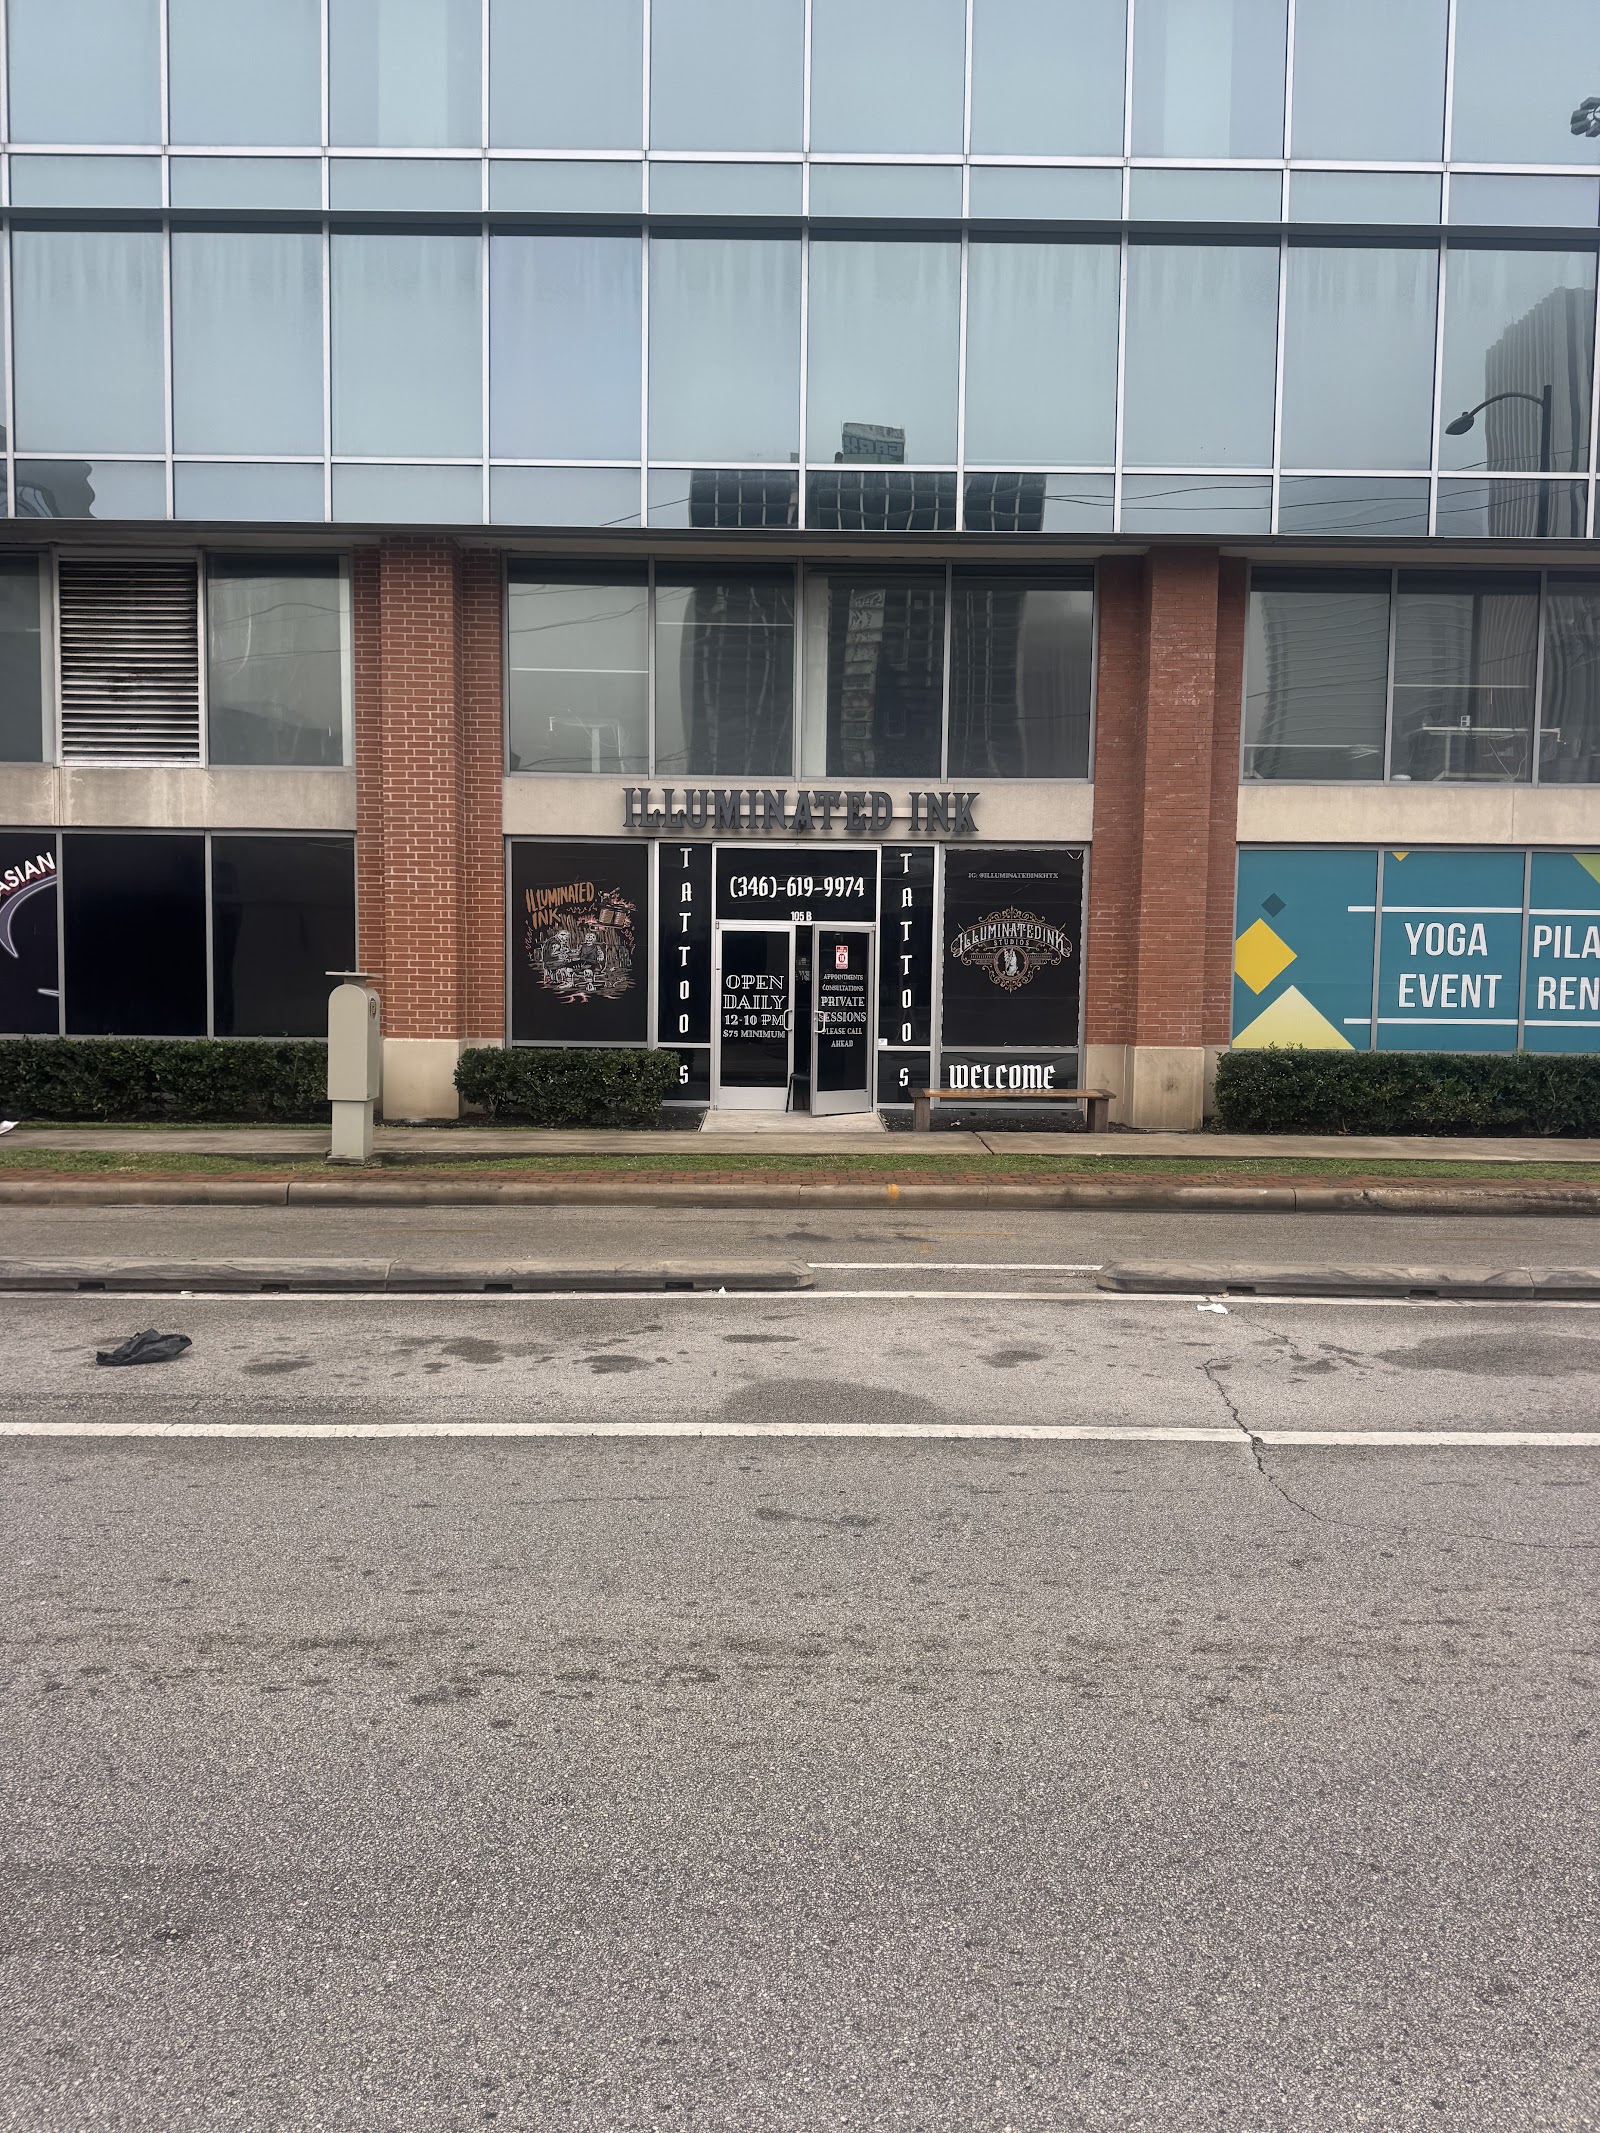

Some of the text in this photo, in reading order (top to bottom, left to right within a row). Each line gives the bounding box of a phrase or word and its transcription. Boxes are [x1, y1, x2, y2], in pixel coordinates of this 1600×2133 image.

[622, 787, 981, 833] ILLUMINATED INK
[729, 876, 865, 899] (346)-619-9974
[525, 881, 595, 913] ILLUMINATED
[531, 907, 562, 930] INK
[790, 911, 812, 921] 105 B
[993, 938, 1030, 946] STUDIOS
[1404, 922, 1488, 956] YOGA
[1532, 925, 1600, 959] PILA
[725, 974, 785, 990] OPEN
[822, 973, 864, 981] APPOINTMENTS
[821, 983, 864, 992] CONSULTATIONS
[1398, 973, 1503, 1009] EVENT
[1537, 976, 1600, 1010] REN
[722, 994, 787, 1010] DAILY
[820, 996, 866, 1007] PRIVATE
[724, 1014, 784, 1026] 12-10 PM
[818, 1011, 867, 1023] SESSIONS
[722, 1029, 786, 1039] $75 MINIMUM
[846, 1027, 862, 1035] CALL
[830, 1039, 854, 1048] AHEAD
[948, 1064, 1056, 1089] WELCOME
